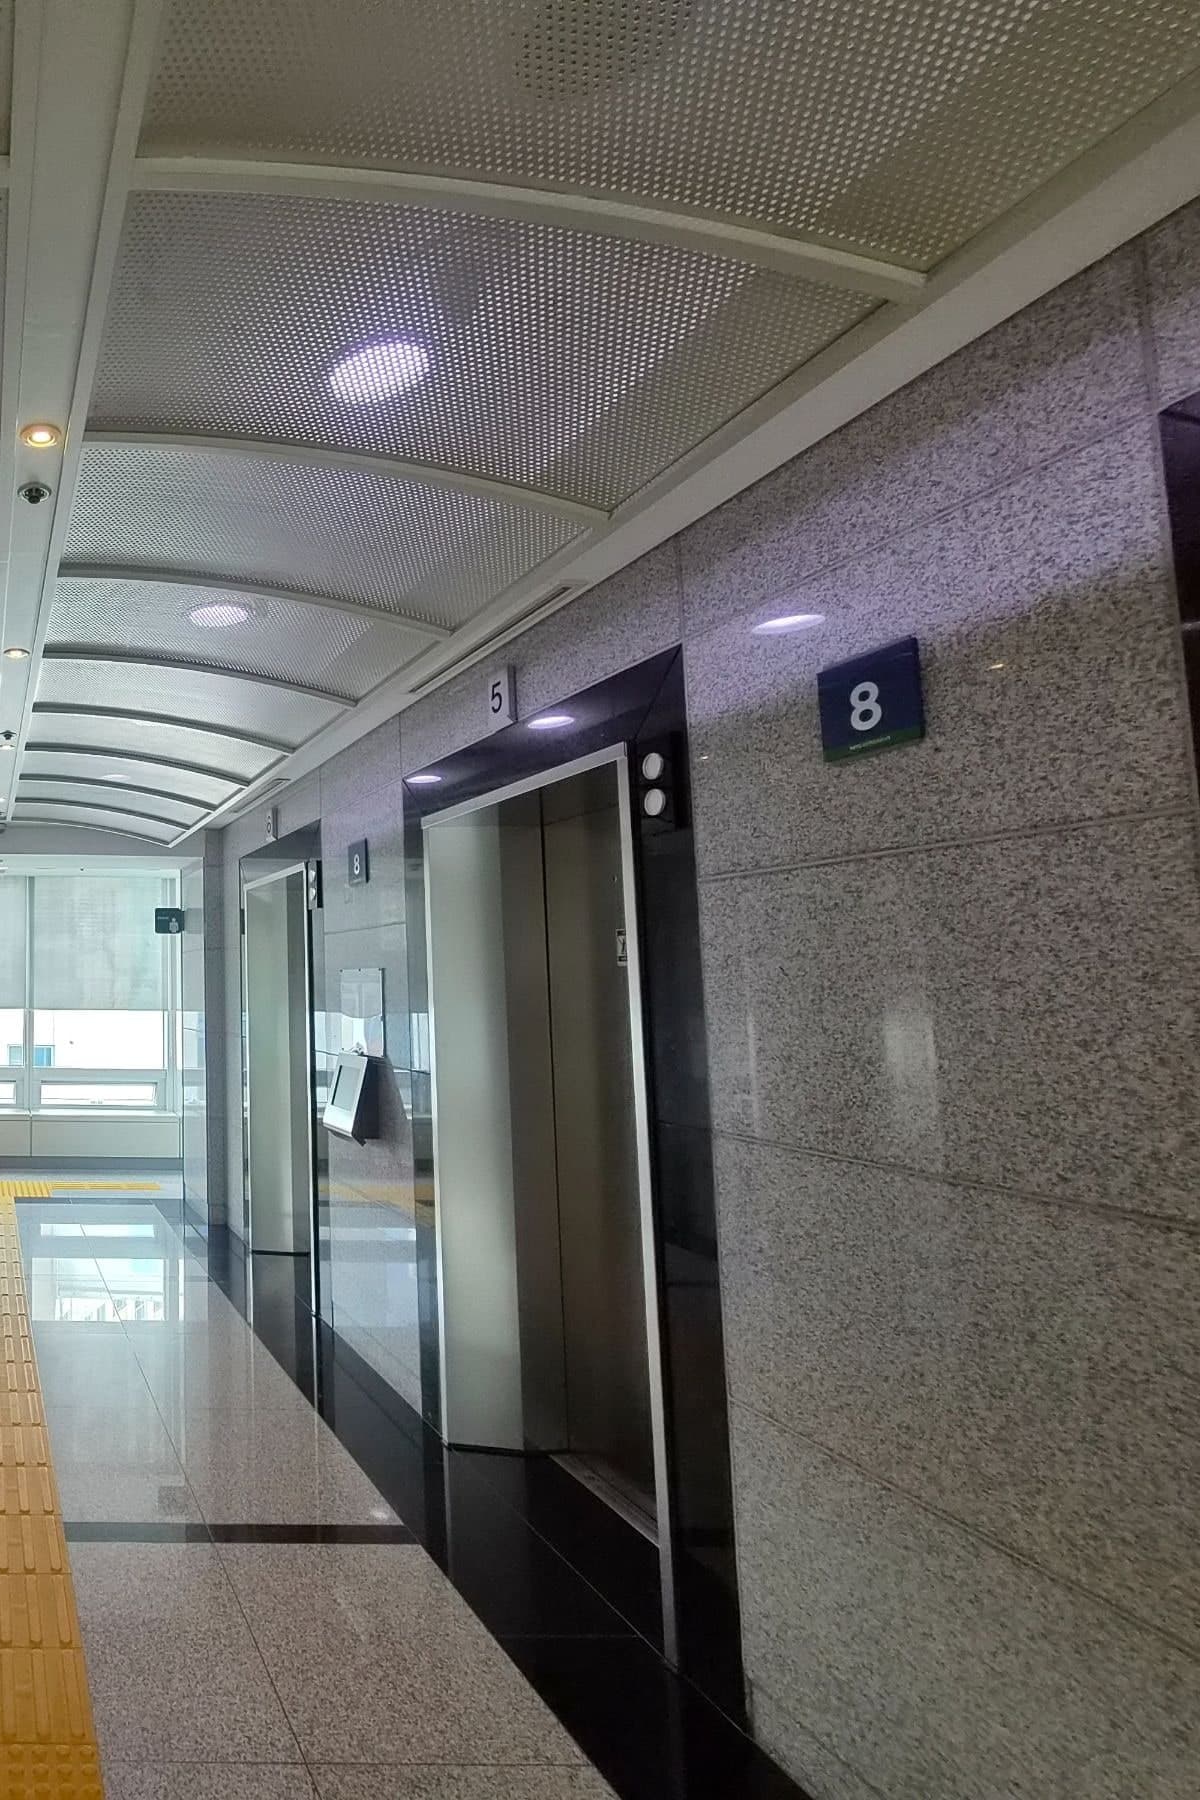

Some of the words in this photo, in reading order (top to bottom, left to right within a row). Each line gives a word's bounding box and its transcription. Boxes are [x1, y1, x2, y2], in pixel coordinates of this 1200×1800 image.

[491, 680, 502, 714] 5
[849, 681, 882, 731] 8
[353, 854, 360, 875] 8
